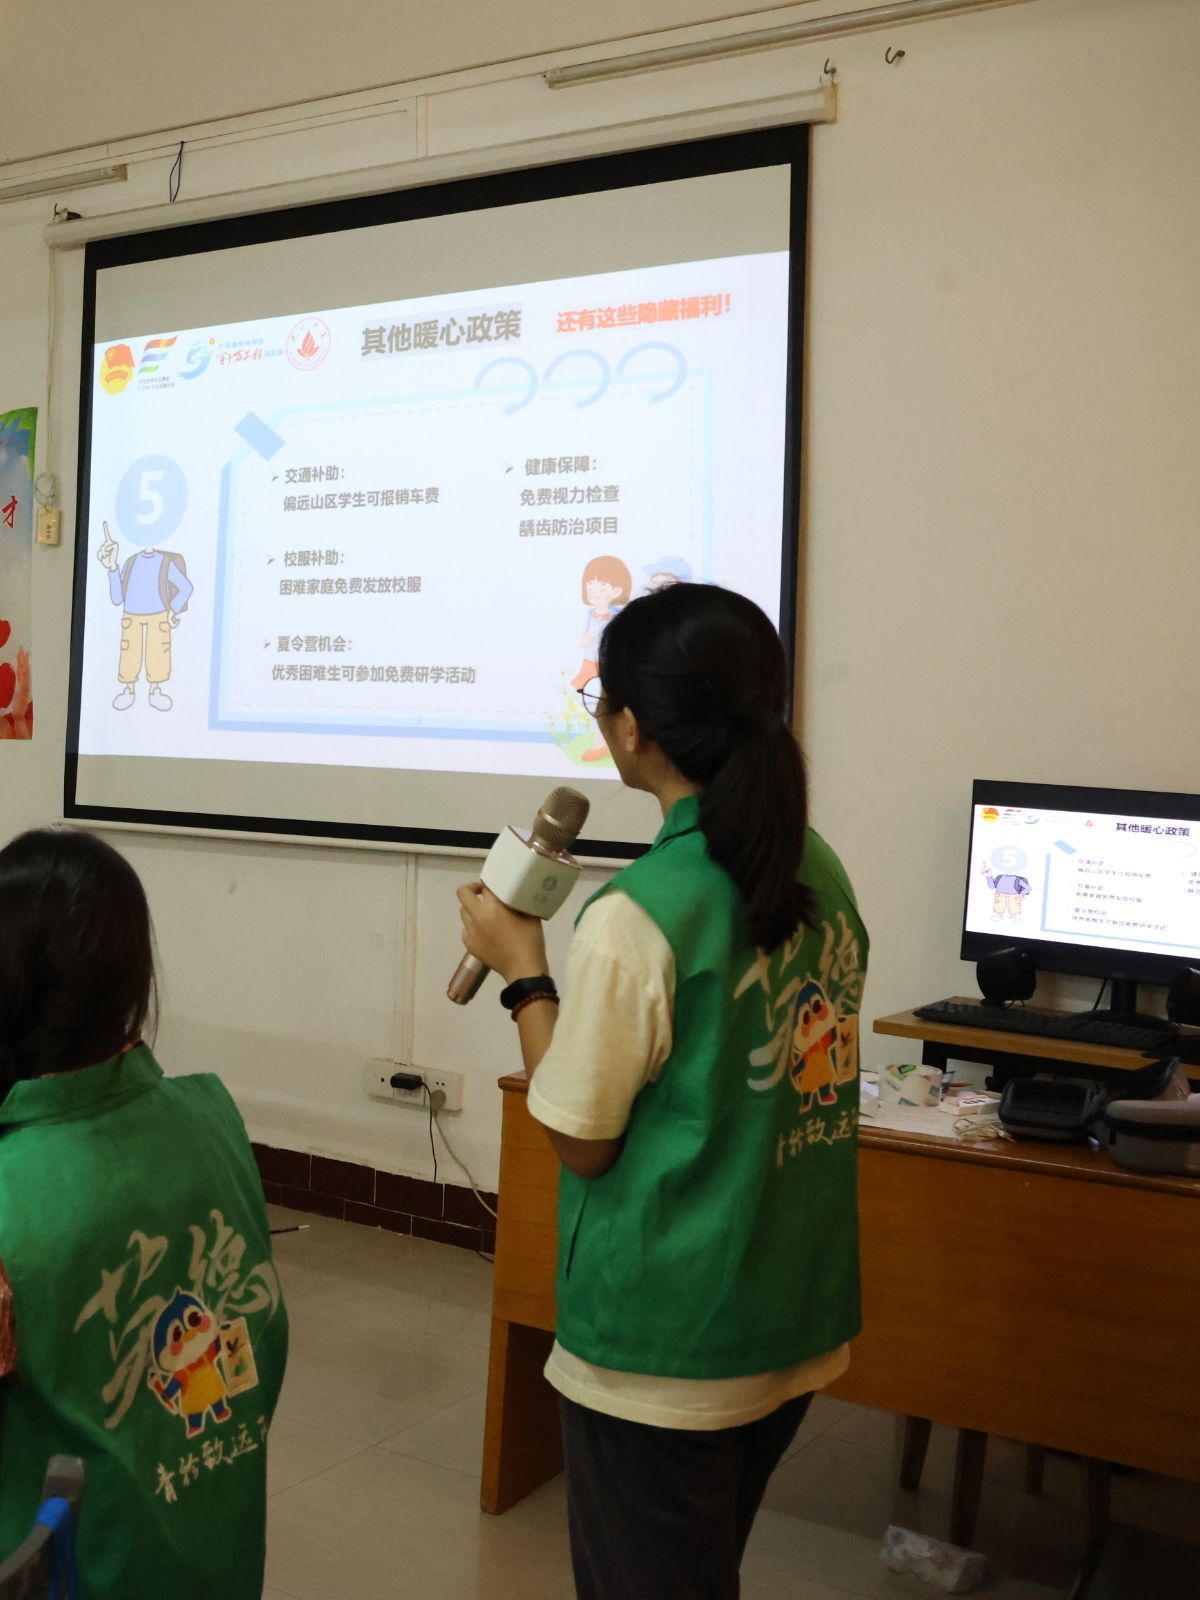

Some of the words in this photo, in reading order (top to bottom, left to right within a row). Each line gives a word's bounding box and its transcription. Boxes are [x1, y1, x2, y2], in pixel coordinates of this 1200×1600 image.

[361, 309, 522, 357] 其他暖心政策
[285, 465, 345, 484] 交通补助：
[525, 455, 597, 475] 健康保障：
[136, 469, 164, 526] 5
[284, 487, 440, 512] 偏远山区学生可报销车费
[520, 484, 620, 506] 免费视力检查
[519, 517, 618, 538] 龋齿防治项目
[284, 549, 344, 568] 校服补助：
[279, 576, 422, 596] 困难家庭免费发放校服
[277, 635, 352, 652] 夏令营机会：
[271, 664, 477, 684] 优秀困难生可参加免费研学活动
[1116, 822, 1191, 837] 其他暖心政策
